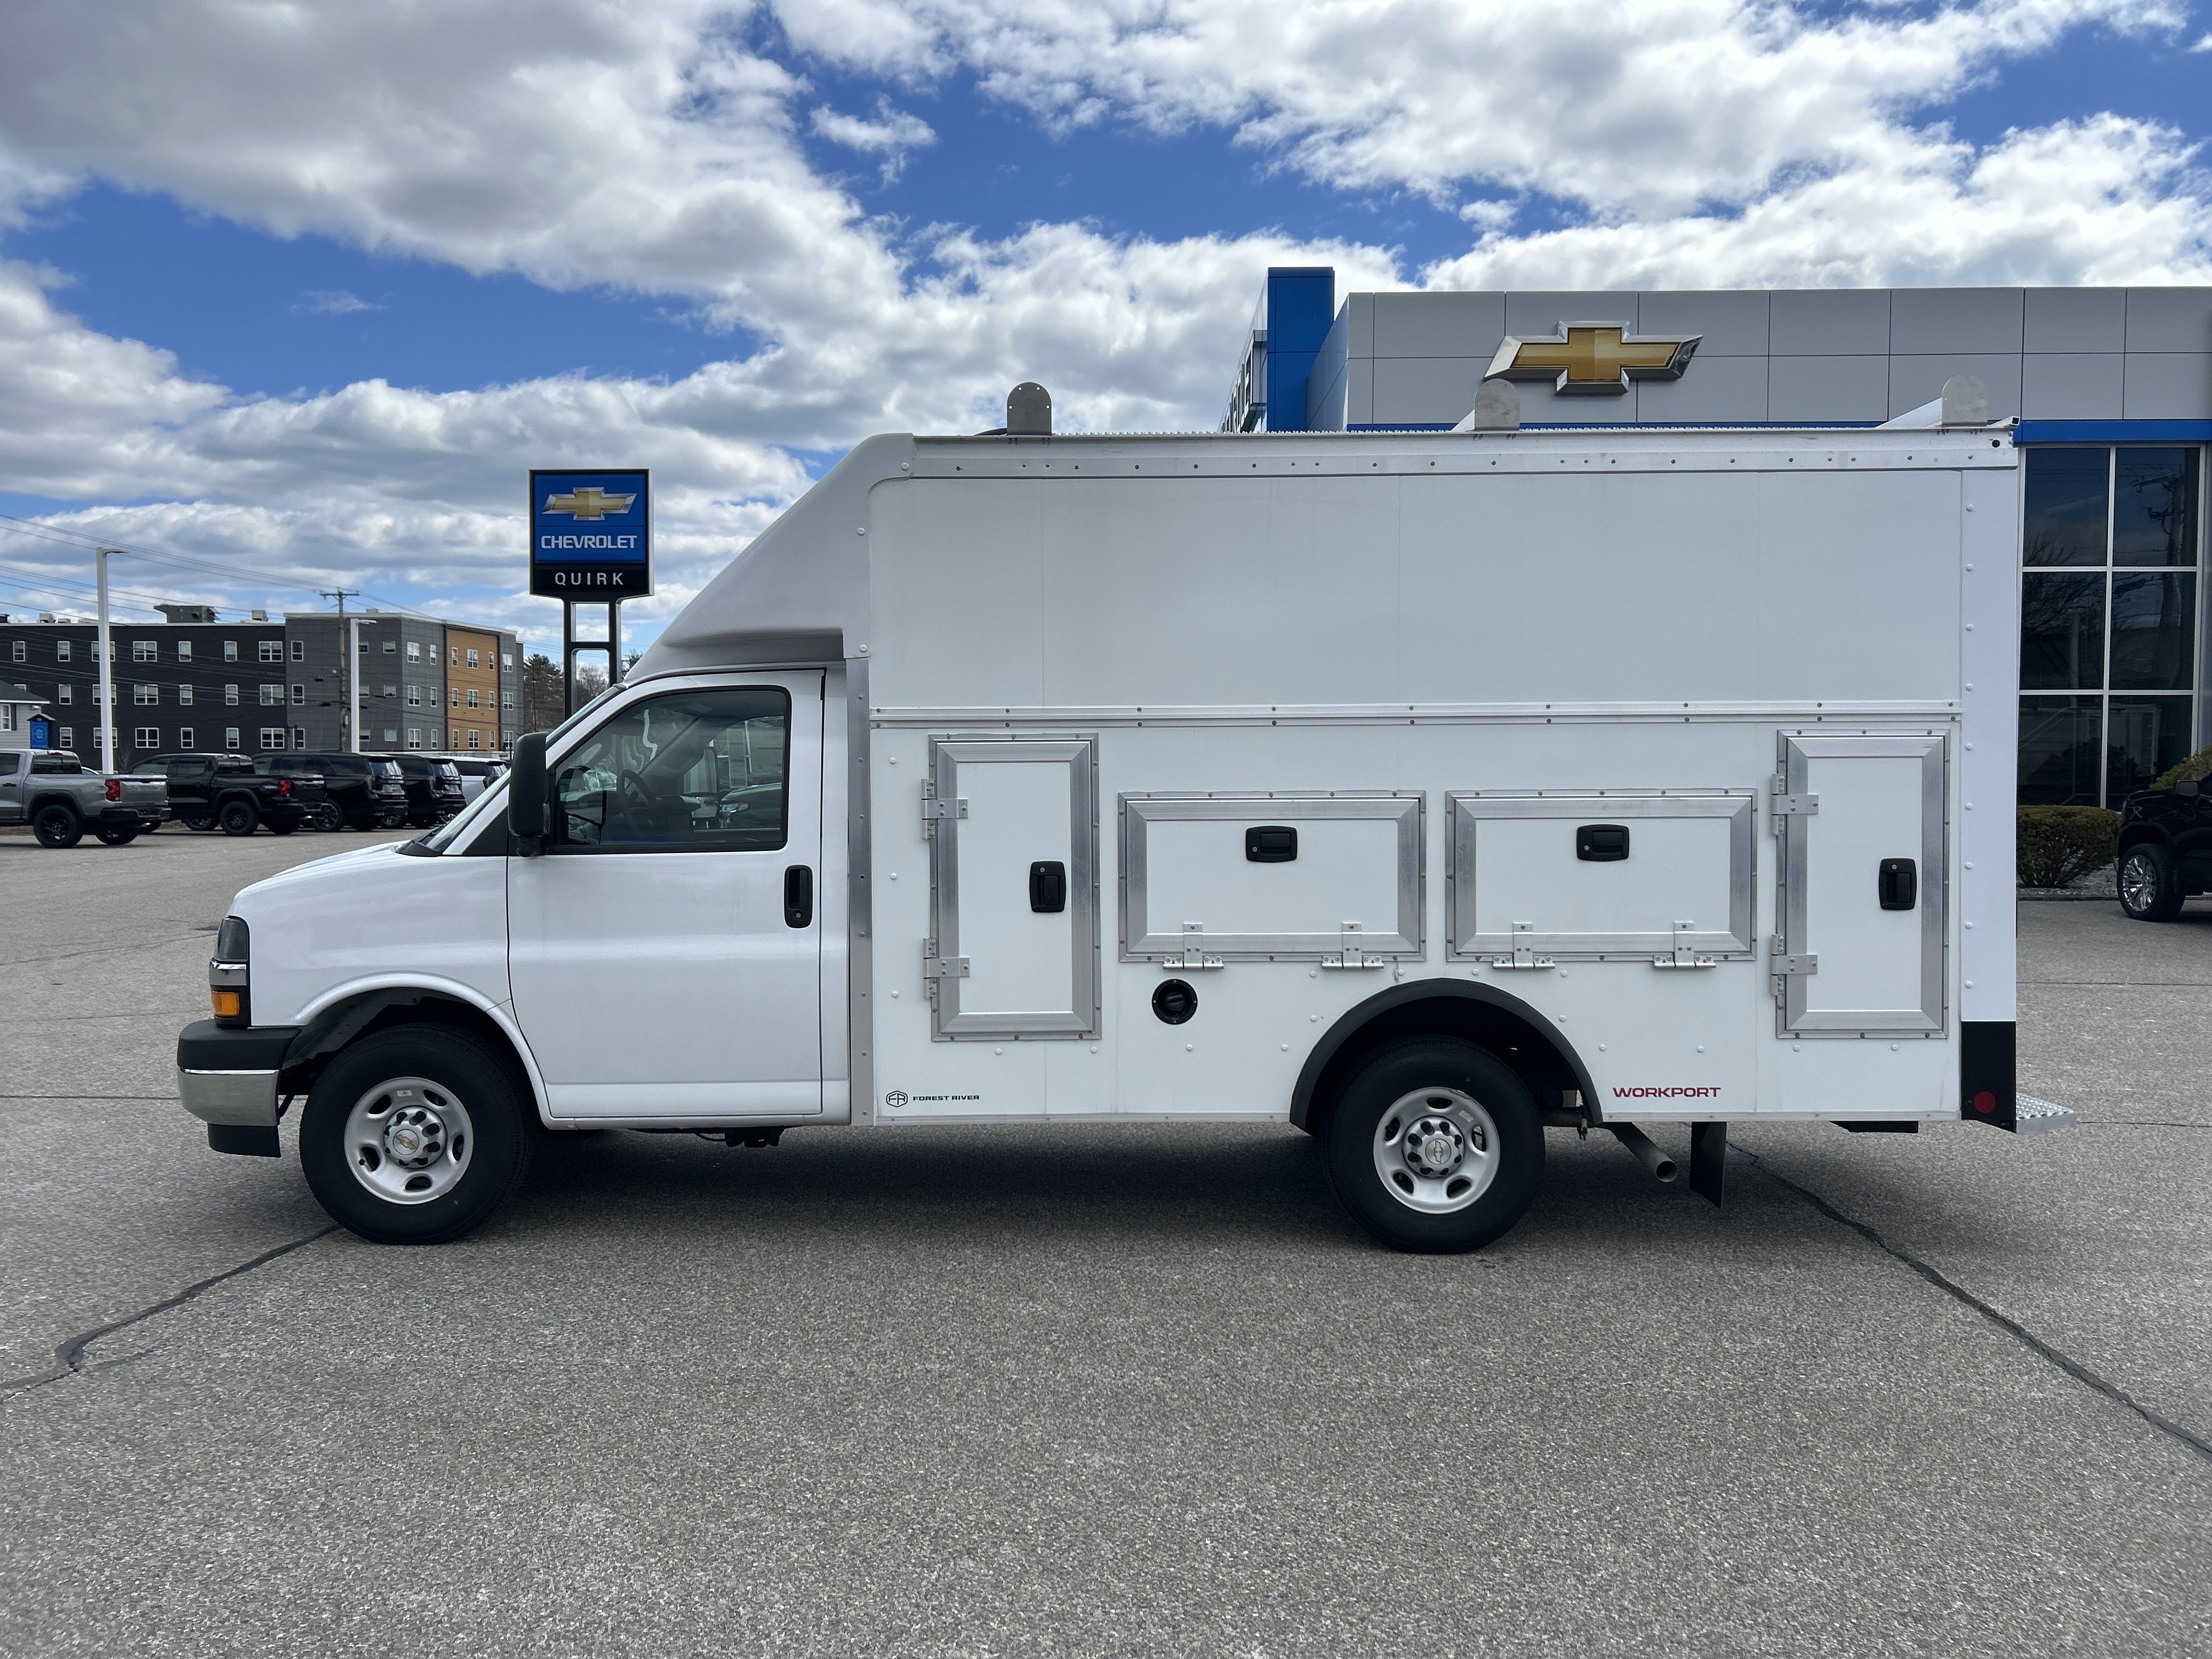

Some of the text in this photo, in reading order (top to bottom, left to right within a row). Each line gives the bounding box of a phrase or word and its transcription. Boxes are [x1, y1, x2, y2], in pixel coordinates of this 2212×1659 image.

[541, 535, 637, 549] CHEVROLET
[555, 572, 624, 586] QUIRK
[1612, 1087, 1721, 1098] WORKPORT
